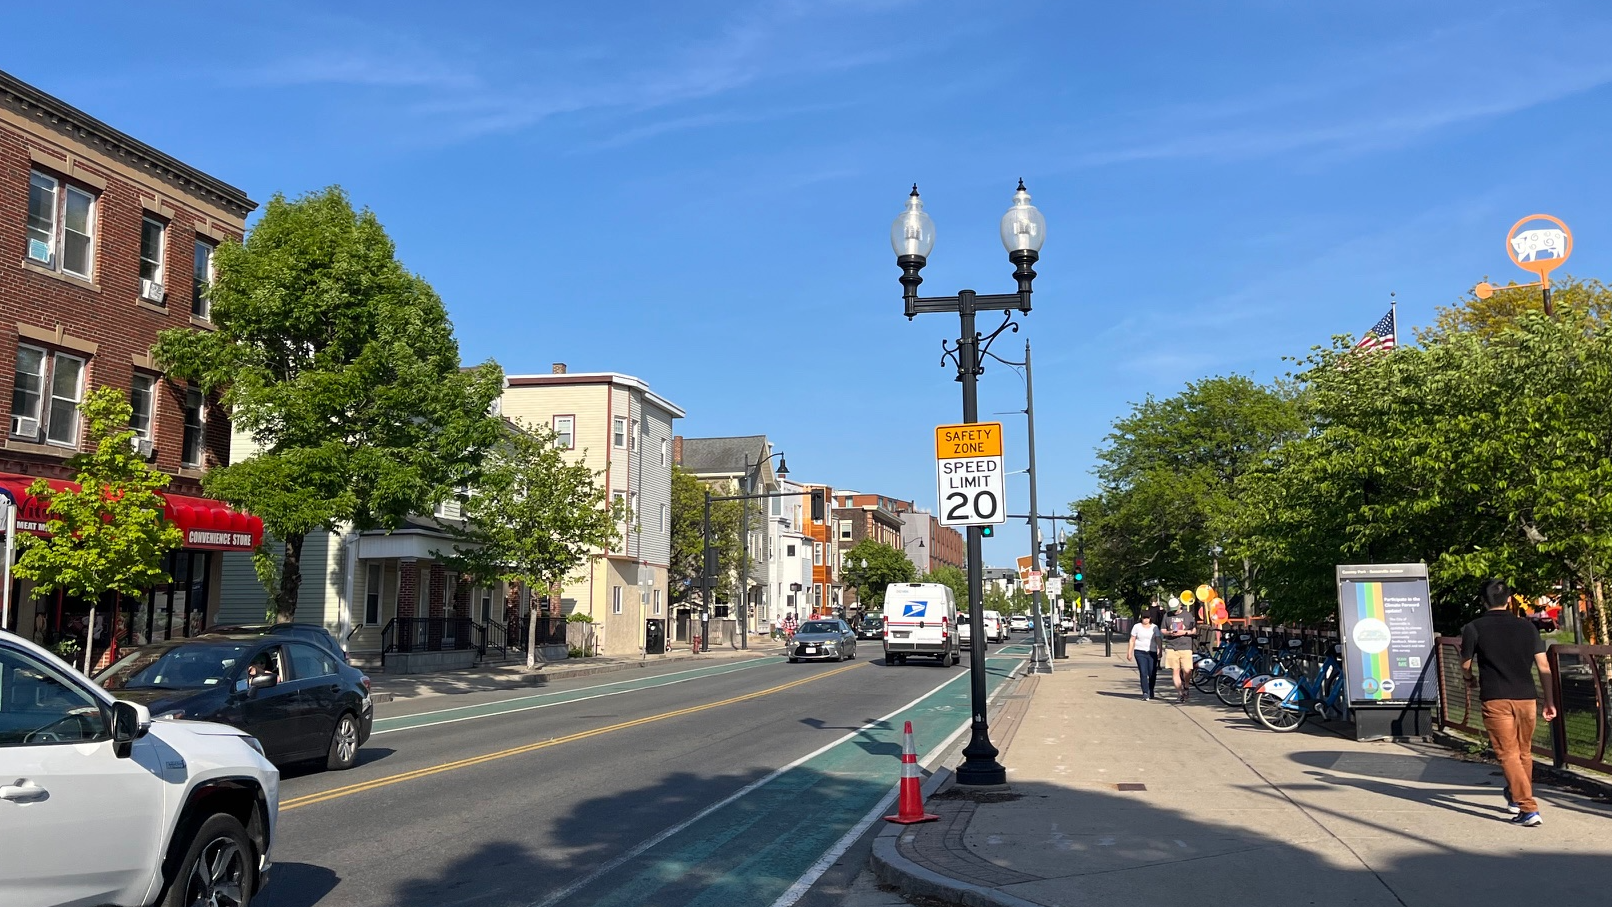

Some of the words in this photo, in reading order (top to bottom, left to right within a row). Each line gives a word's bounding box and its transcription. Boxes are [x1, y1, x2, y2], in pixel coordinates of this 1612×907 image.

[945, 429, 992, 442] SAFETY
[954, 442, 985, 454] ZONE
[943, 460, 997, 475] SPEED
[949, 475, 991, 489] LIMIT
[946, 490, 997, 520] 20
[16, 521, 37, 530] MEAT
[189, 531, 231, 545] CONVENIENCE
[232, 534, 252, 546] STORE
